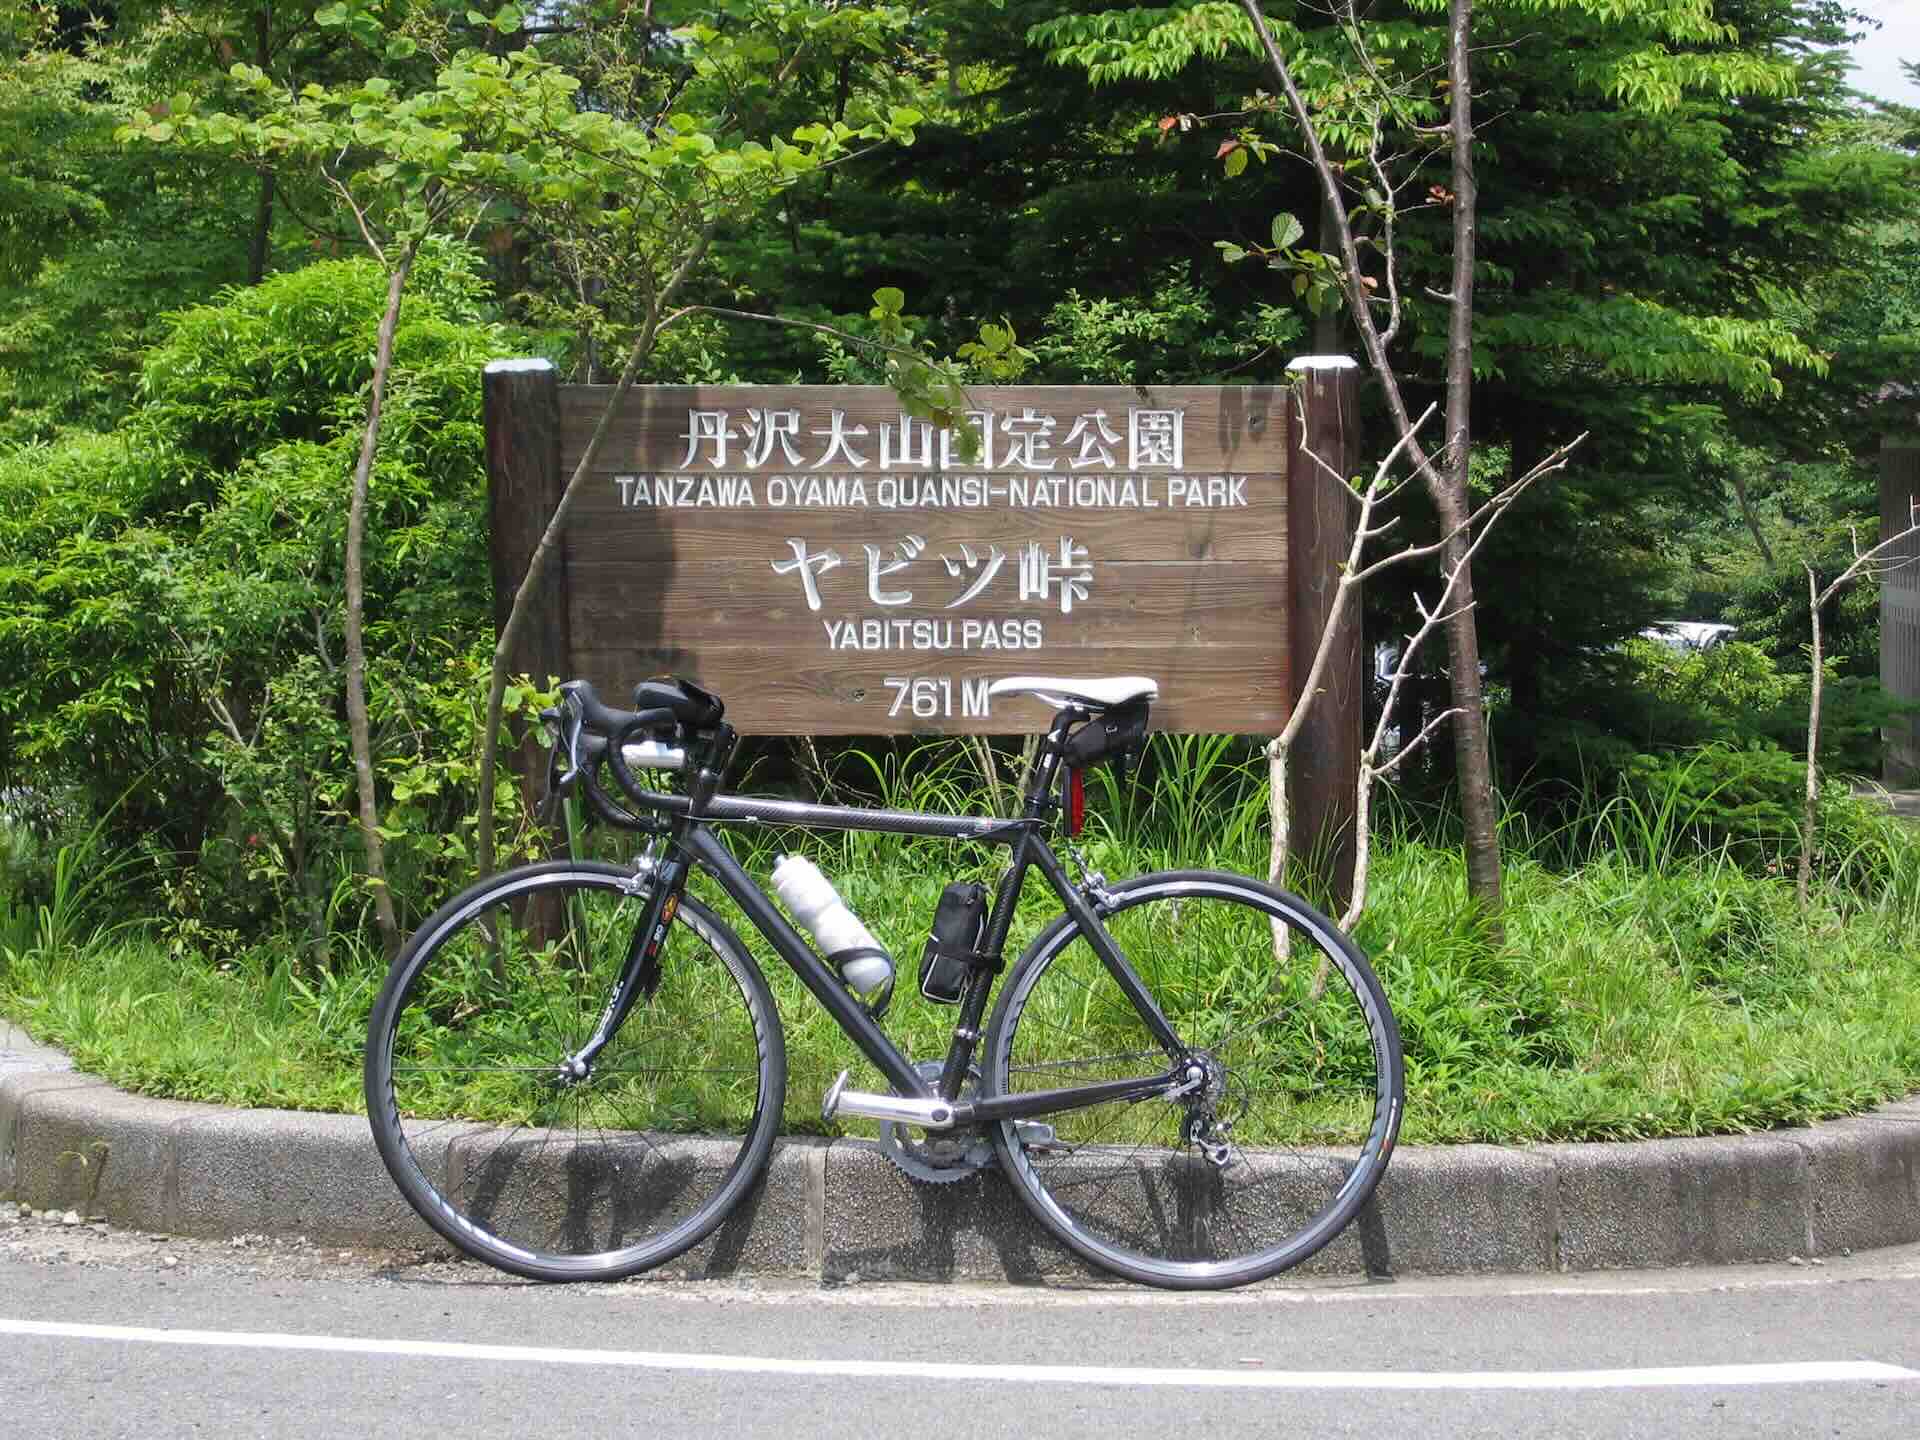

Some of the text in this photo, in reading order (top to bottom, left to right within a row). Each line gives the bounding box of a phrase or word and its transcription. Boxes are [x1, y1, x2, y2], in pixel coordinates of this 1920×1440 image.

[616, 475, 1248, 509] TANZAWA OYAMA QUANSI-NATIONAL PARK
[771, 535, 1094, 613] ヤビツ峠
[823, 619, 1043, 650] YABITSU PASS
